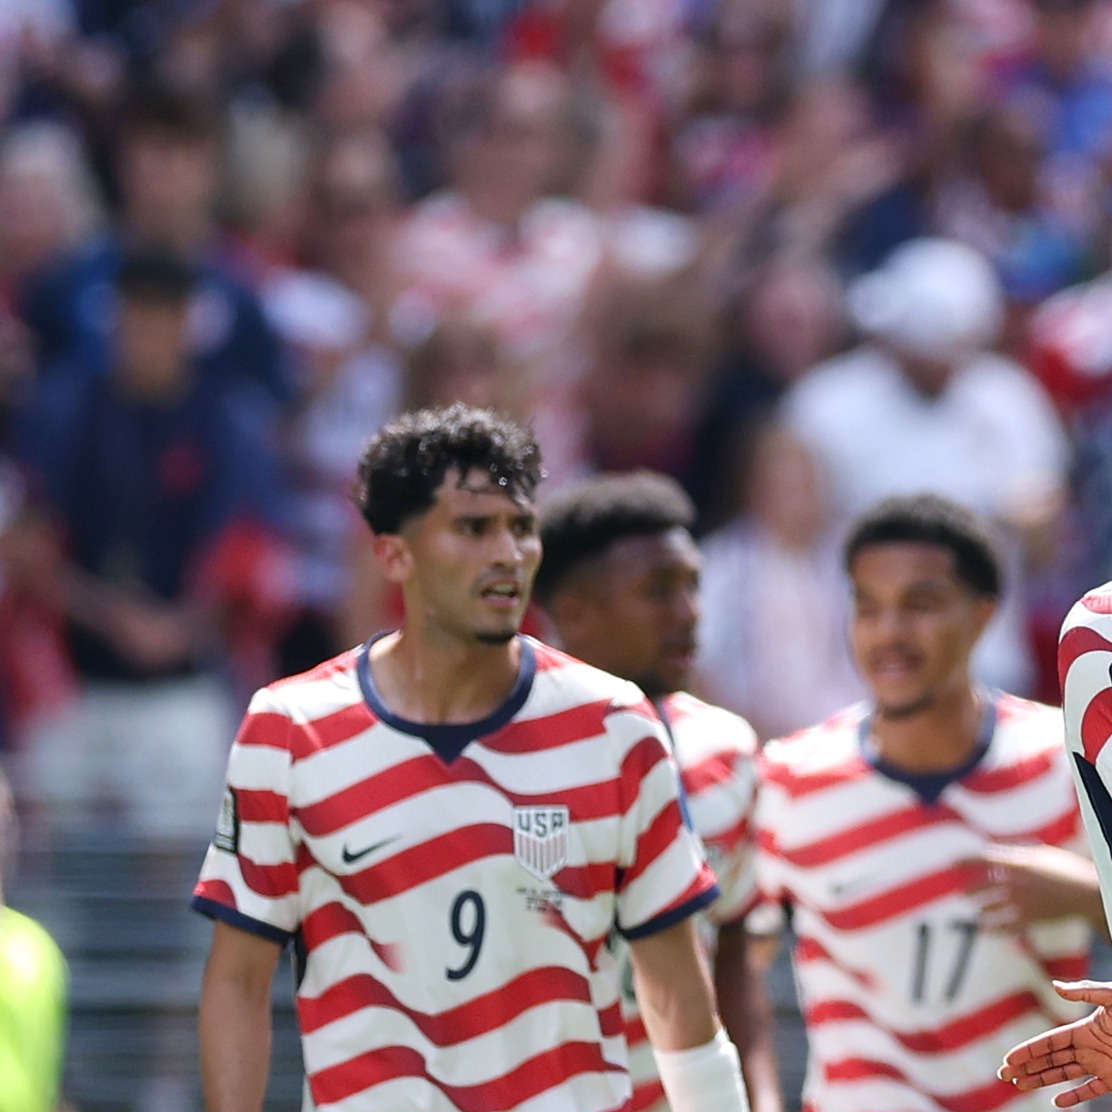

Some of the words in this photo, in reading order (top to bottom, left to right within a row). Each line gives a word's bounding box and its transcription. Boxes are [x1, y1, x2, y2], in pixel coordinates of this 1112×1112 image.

[517, 812, 564, 837] USA
[446, 890, 485, 981] 9
[911, 921, 978, 1004] 17
